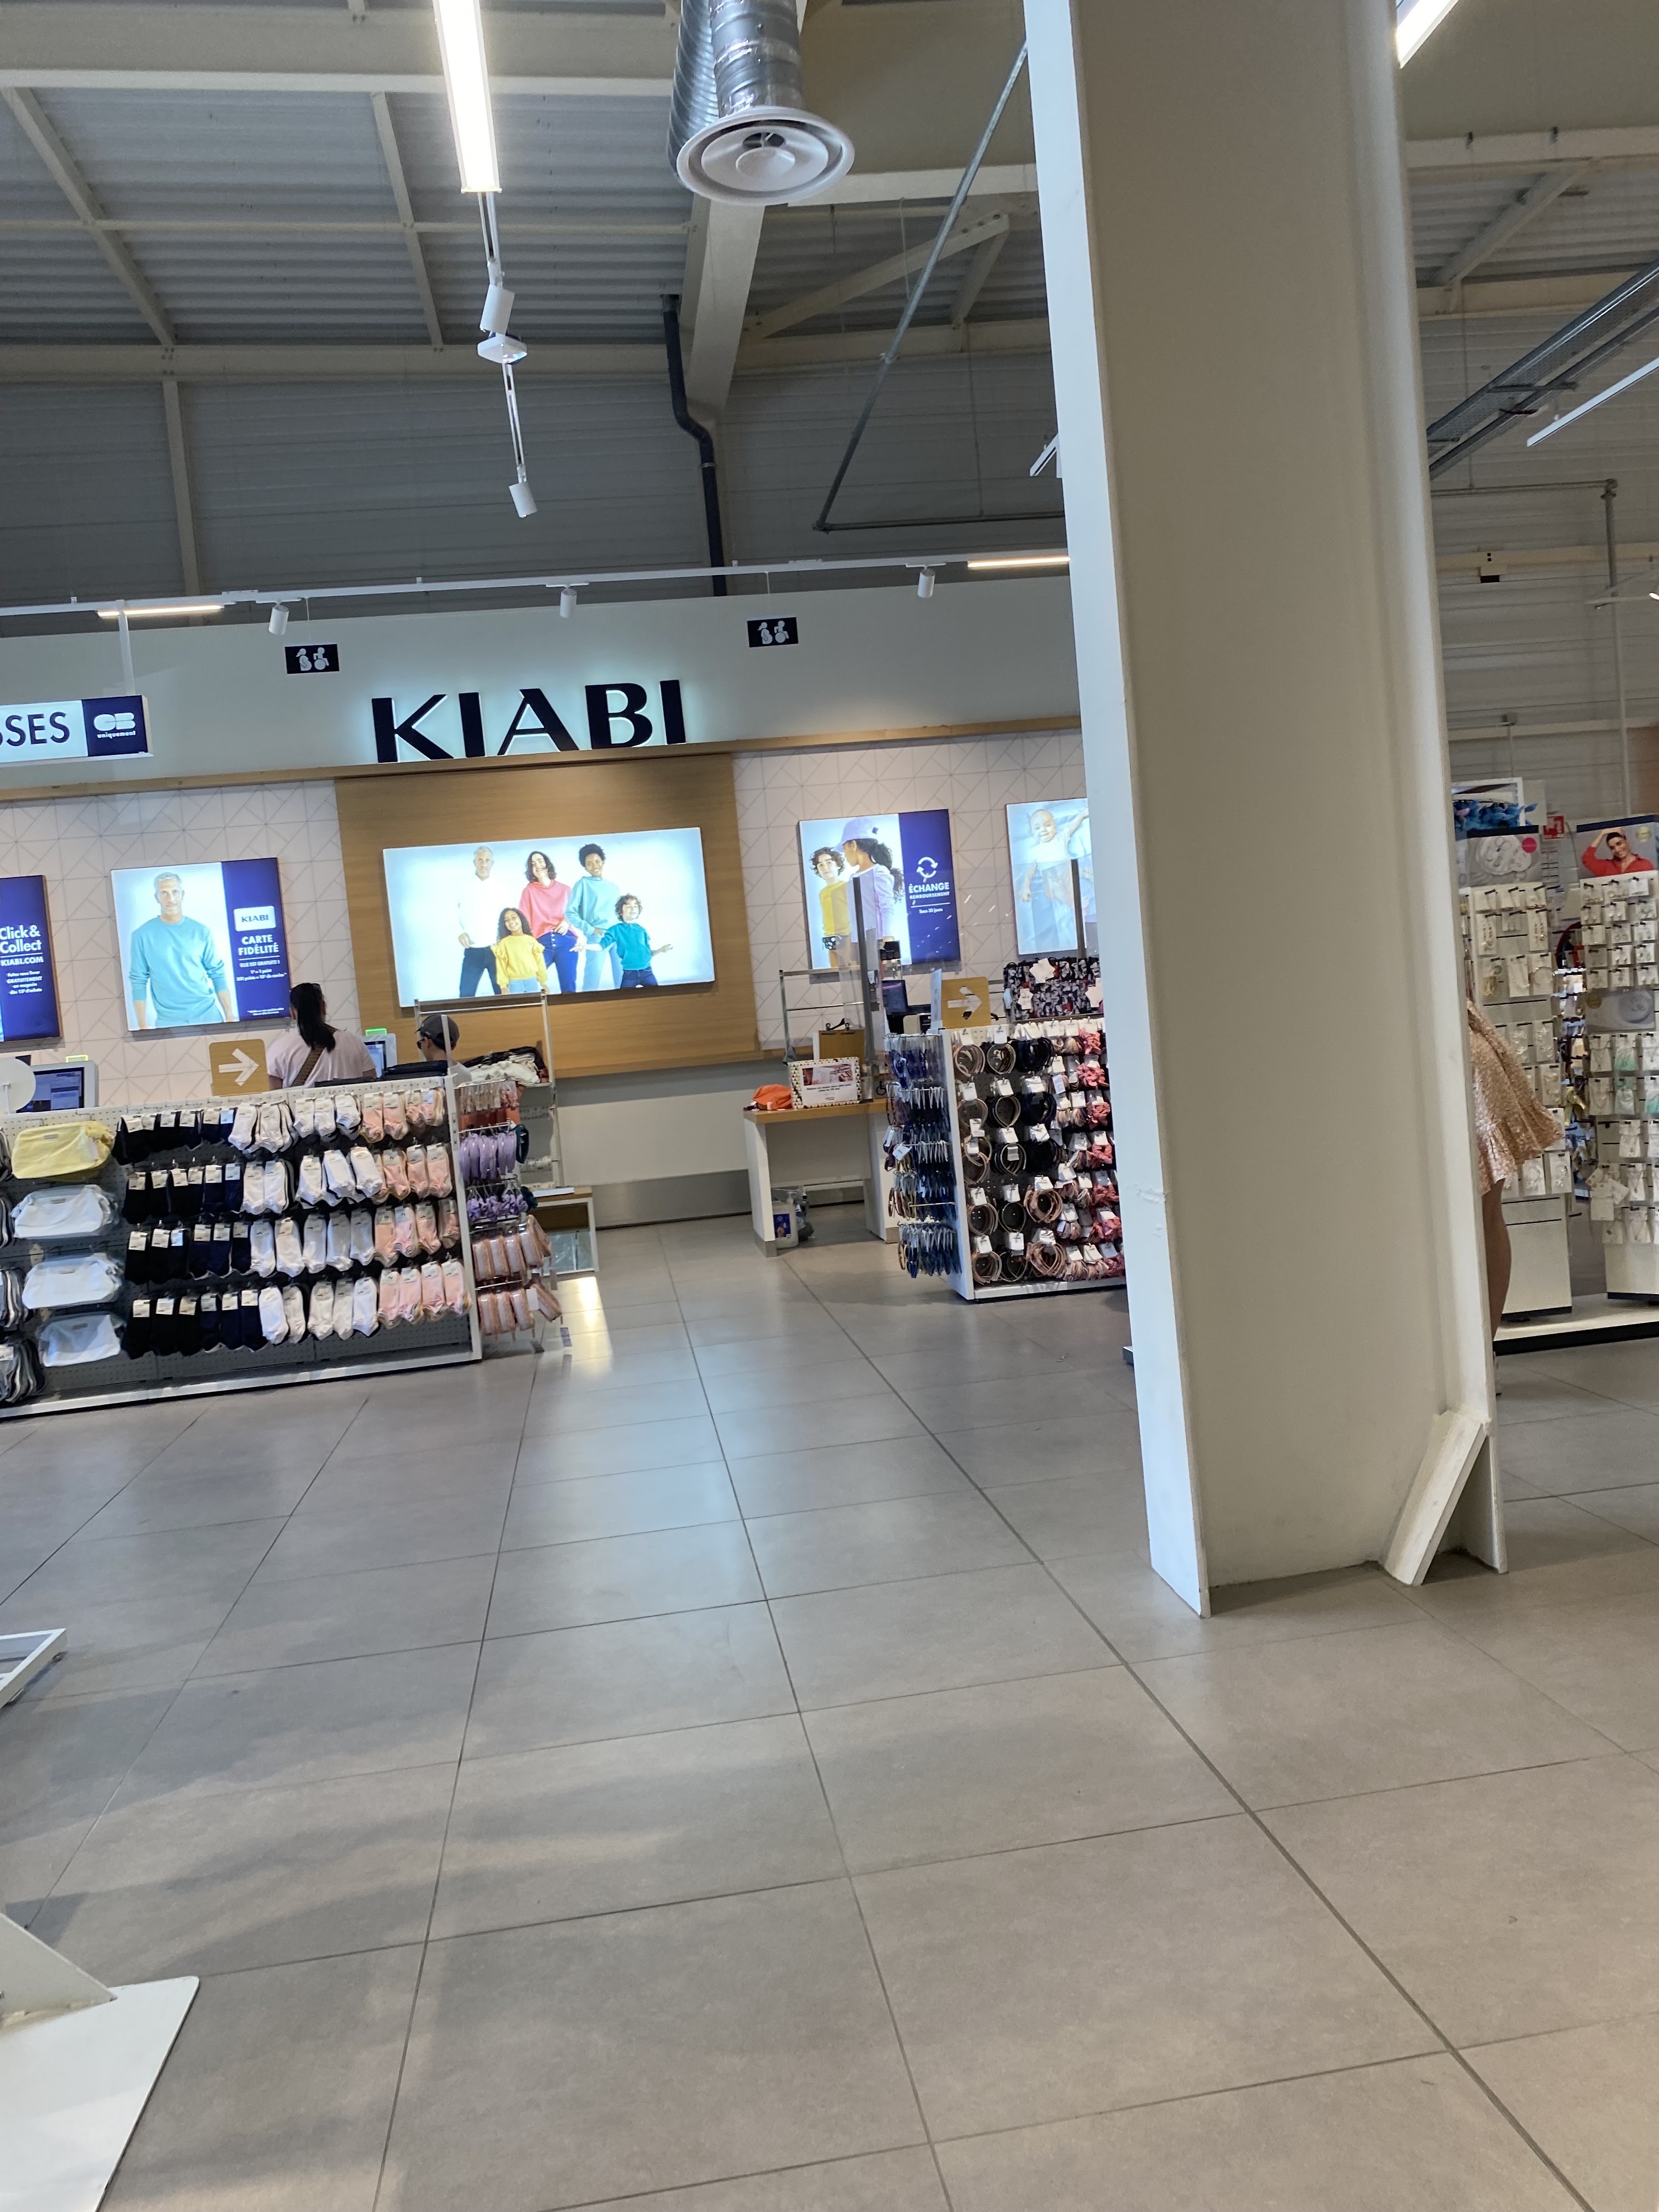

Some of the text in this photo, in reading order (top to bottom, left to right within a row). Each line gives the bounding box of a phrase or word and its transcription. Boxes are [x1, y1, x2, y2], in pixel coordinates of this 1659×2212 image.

[371, 680, 686, 763] KIABI
[0, 712, 70, 747] SES
[97, 730, 136, 739] uniquement
[909, 882, 950, 894] ÉCHANGE
[241, 934, 273, 945] CARTE
[0, 939, 42, 953] Collect
[238, 943, 280, 956] FIDÉLITÉ
[1, 956, 44, 967] KIABI.COM
